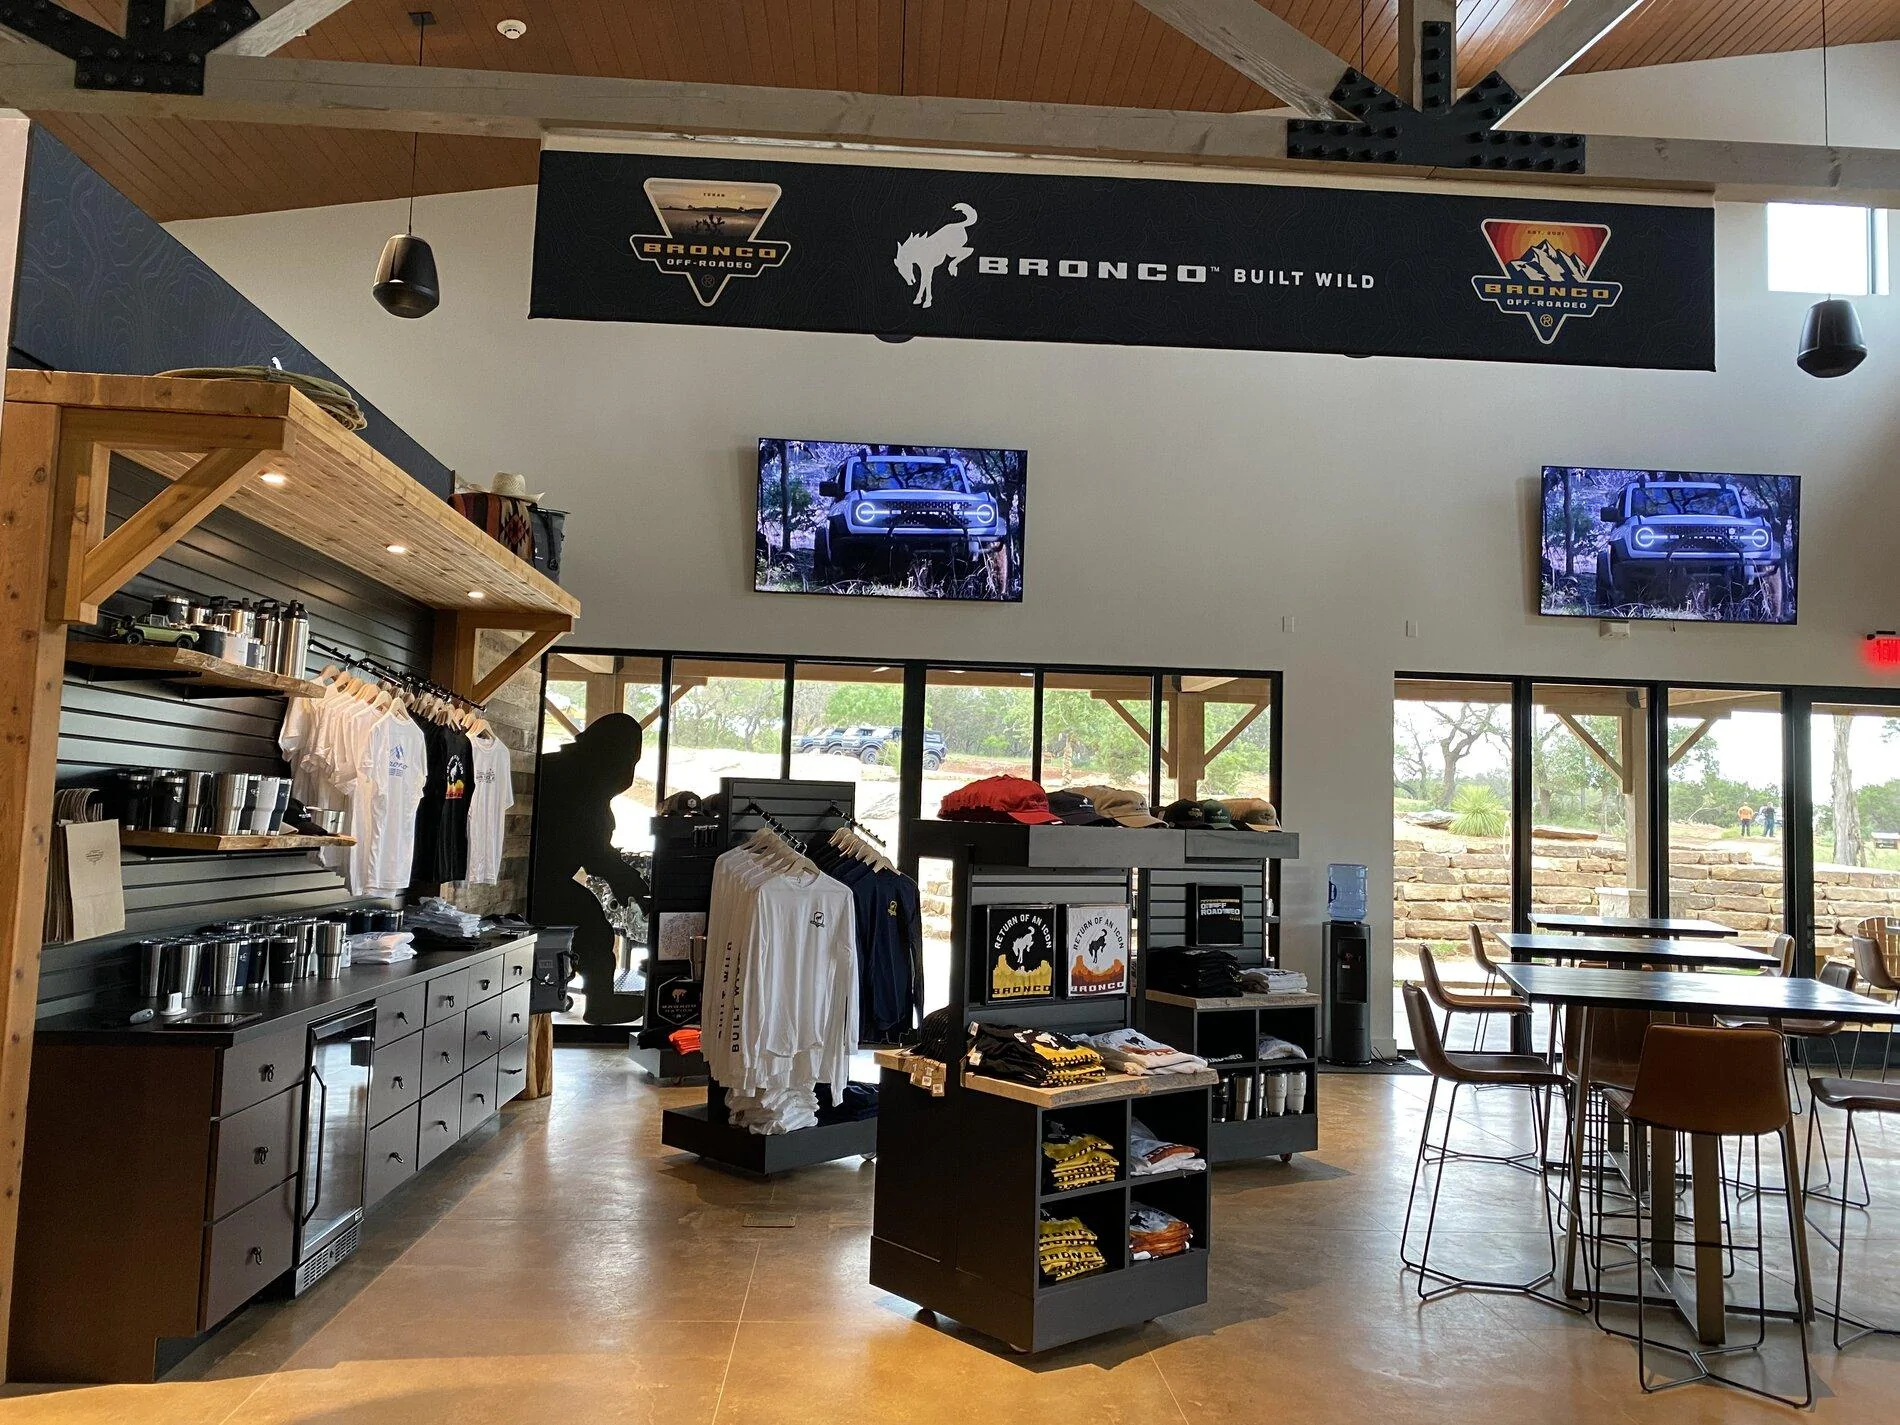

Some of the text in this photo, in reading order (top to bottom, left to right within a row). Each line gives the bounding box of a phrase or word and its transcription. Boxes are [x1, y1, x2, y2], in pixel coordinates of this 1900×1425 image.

[643, 243, 777, 259] BRONCO
[666, 258, 752, 269] OFF-ROADEO
[1233, 268, 1304, 286] BUILT
[1315, 272, 1375, 290] WILD
[1484, 283, 1609, 299] BRONCO
[1507, 298, 1587, 309] OFF-ROADEO
[994, 914, 1052, 949] RETURN OF AN ICON
[1073, 916, 1124, 950] RETURN OF AN ICON
[731, 1004, 740, 1053] BUILT
